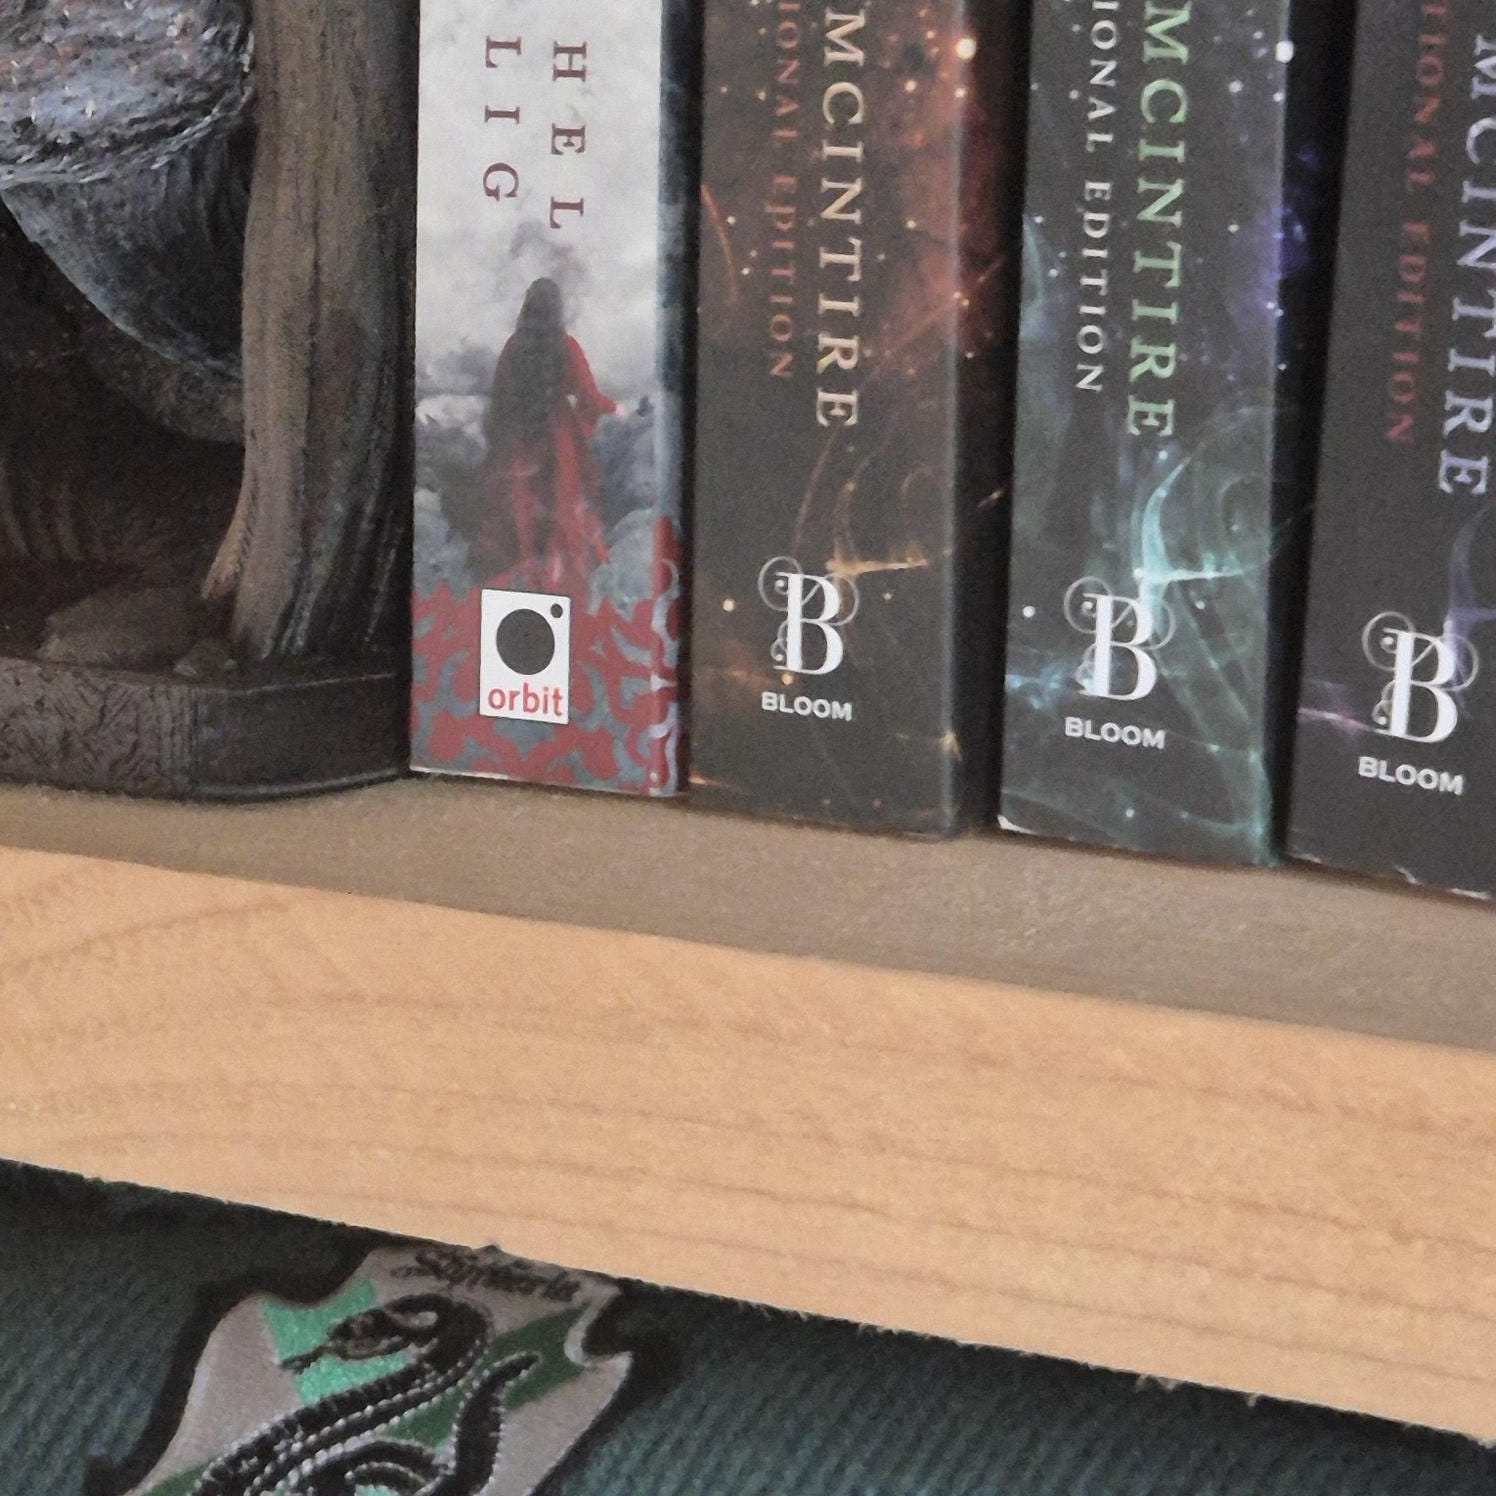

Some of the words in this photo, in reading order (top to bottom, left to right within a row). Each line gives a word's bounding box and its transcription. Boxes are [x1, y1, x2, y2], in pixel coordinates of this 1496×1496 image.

[766, 174, 800, 379] EDITION
[814, 7, 870, 428] MCINTIRE
[1073, 180, 1113, 394] EDITION
[1125, 0, 1194, 439] MCINTIRE
[1385, 219, 1429, 443] EDITION
[486, 680, 566, 718] orbit
[760, 689, 854, 722] BLOOM
[1064, 716, 1166, 751] BLOOM
[1357, 754, 1464, 797] BLOOM
